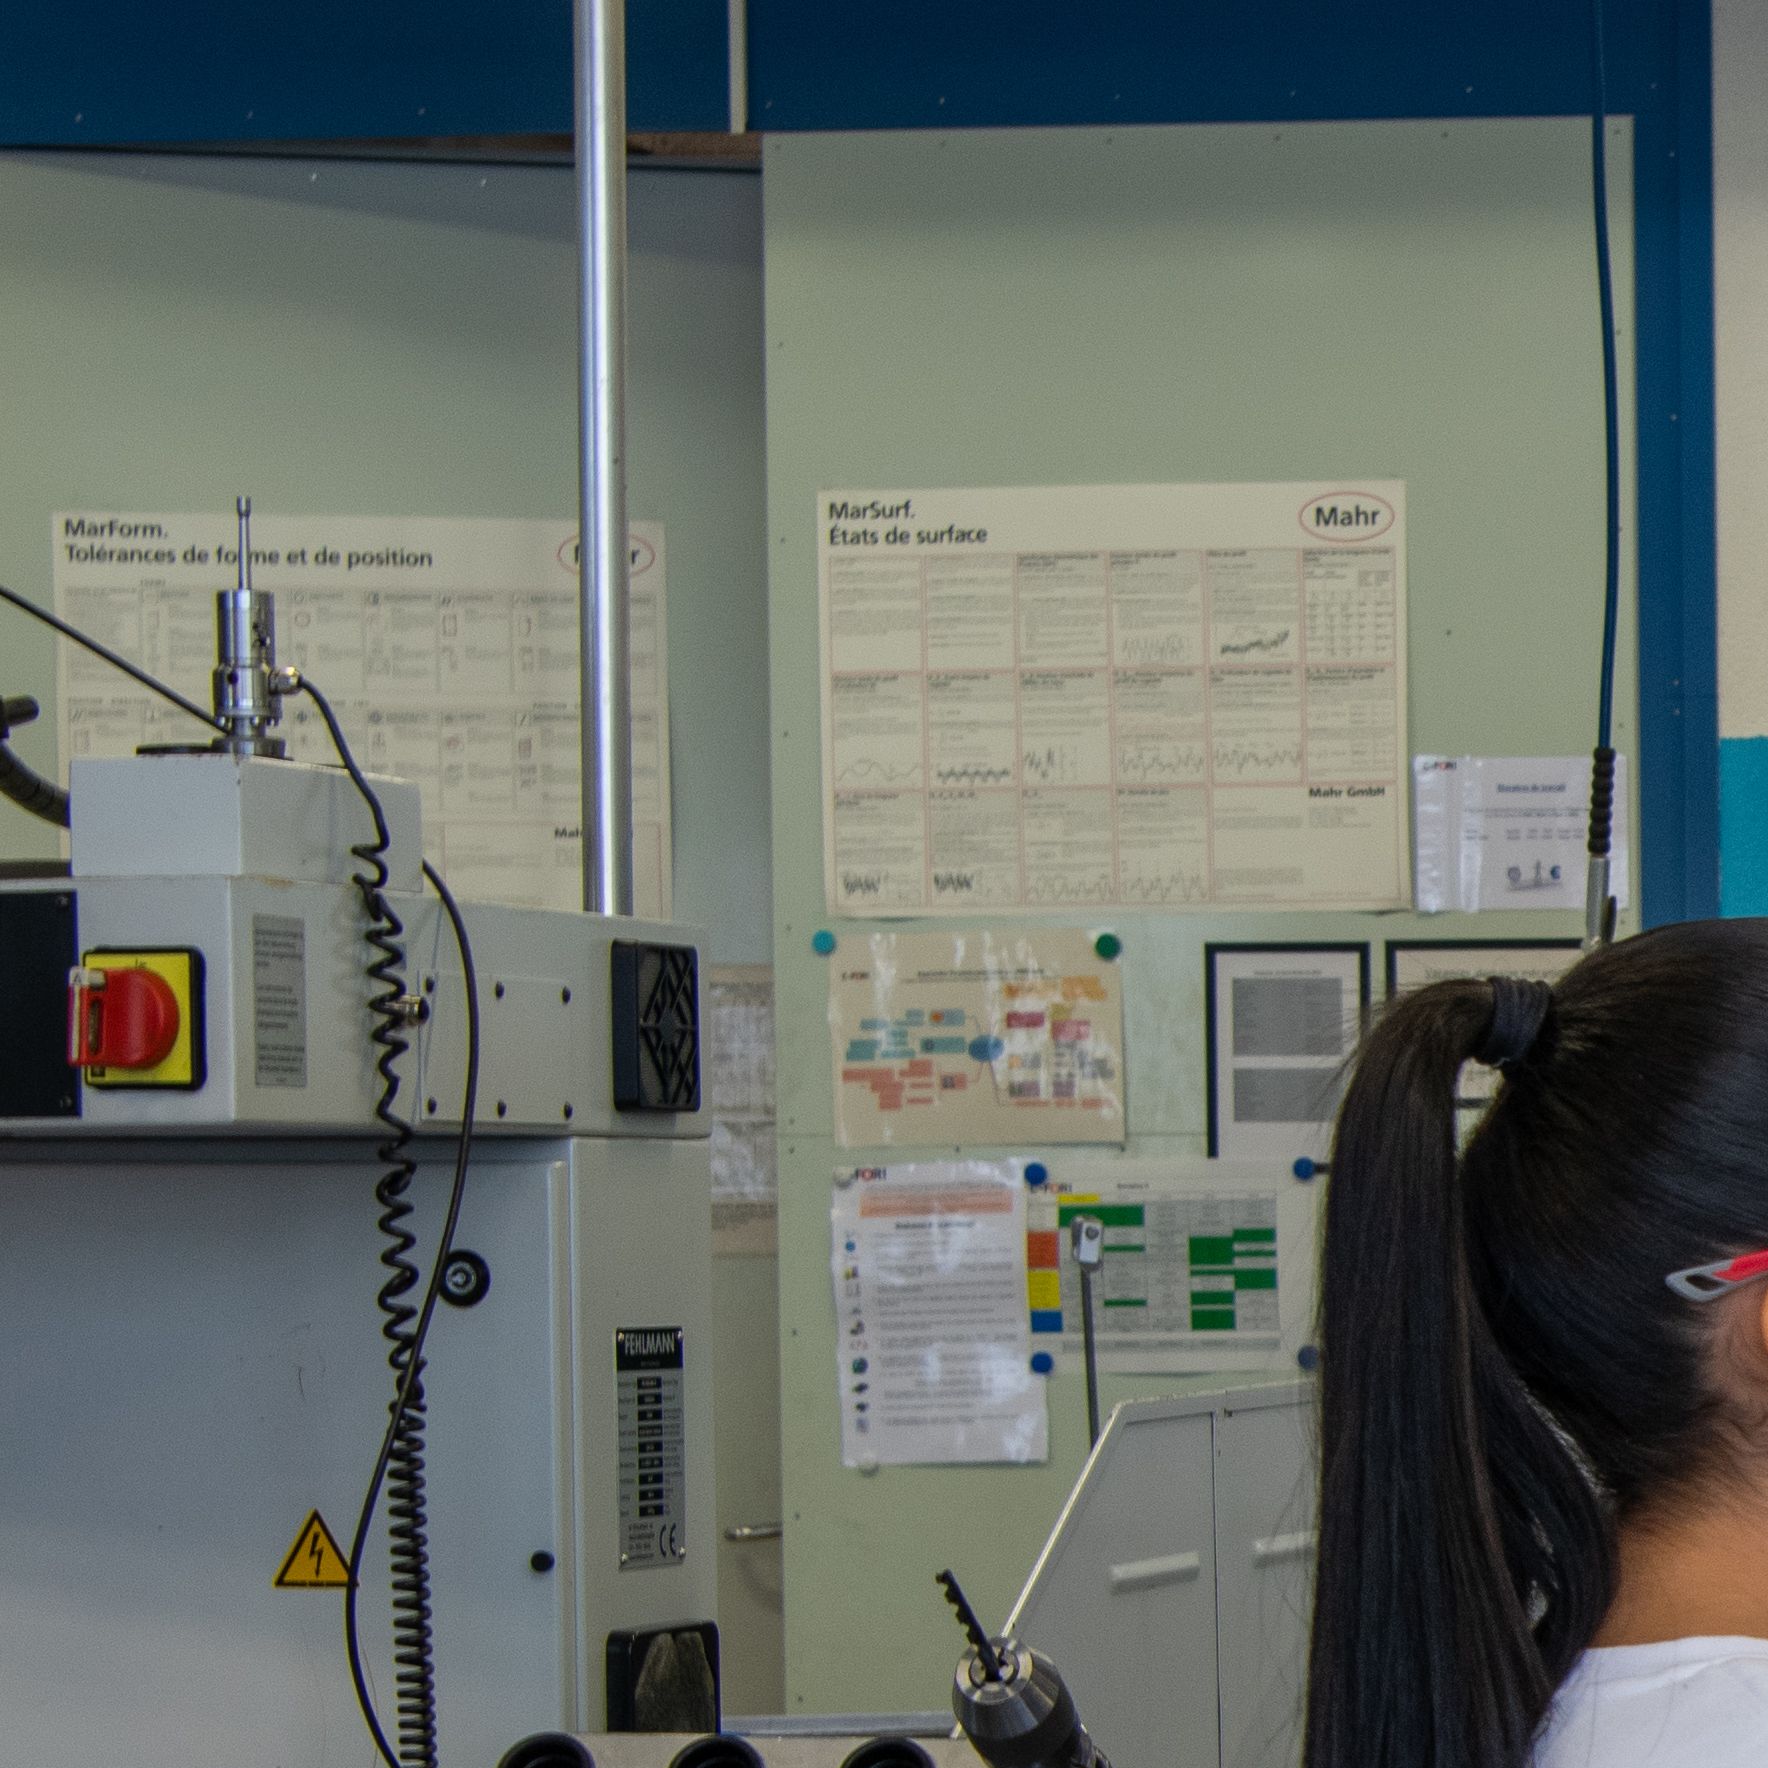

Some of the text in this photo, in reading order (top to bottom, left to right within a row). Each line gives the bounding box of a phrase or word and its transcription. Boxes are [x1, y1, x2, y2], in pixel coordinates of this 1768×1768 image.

[828, 500, 916, 520] MarSurf.
[1315, 505, 1380, 528] Mahr
[64, 518, 168, 540] MarForm.
[828, 523, 988, 546] États de surface
[65, 543, 433, 571] Tolérances de fome et de position
[1308, 785, 1386, 798] Mahr GmbH
[624, 1332, 676, 1357] FEHLMANN
